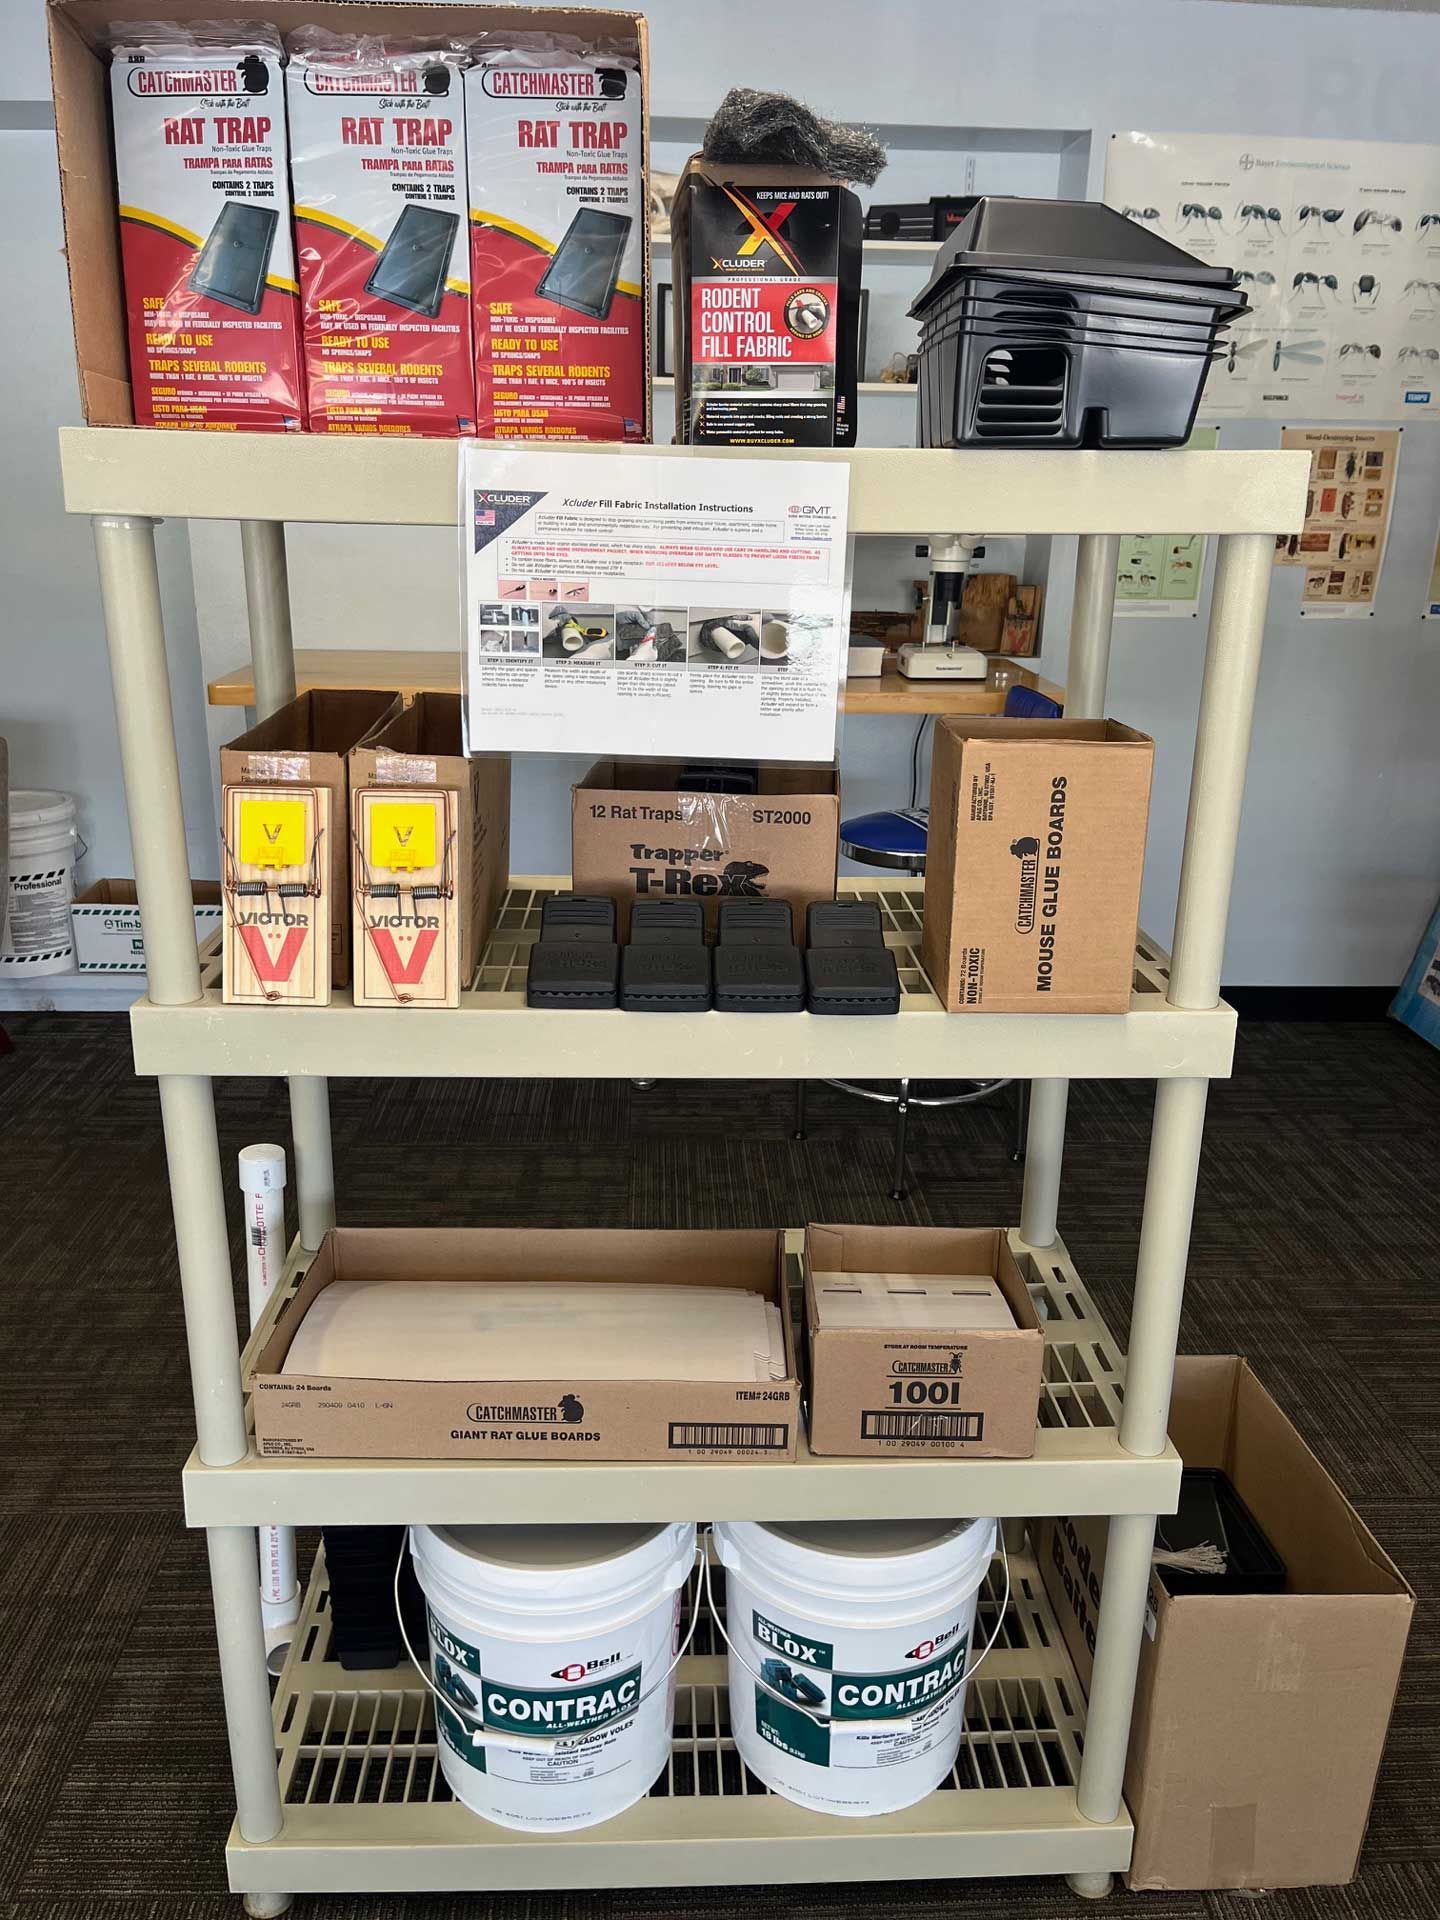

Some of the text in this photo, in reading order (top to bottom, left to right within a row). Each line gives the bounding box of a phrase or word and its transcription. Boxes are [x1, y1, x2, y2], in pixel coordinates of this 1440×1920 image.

[138, 70, 237, 93] CATCHMASTER
[493, 72, 594, 96] CATCHMASTER
[164, 117, 271, 144] RAT TRAP
[342, 117, 452, 146] RAT TRAP
[518, 120, 628, 148] RAT TRAP
[566, 150, 628, 159] Non-Toxic Glue Traps
[184, 157, 273, 168] TRAMPA PARA RATAS
[361, 159, 454, 172] TRAMPA PARA RATAS
[536, 162, 628, 174] TRAMPA PARA RATAS
[212, 181, 274, 190] CONTAINS 2 TRAPS
[566, 187, 628, 196] CONTAINS 2 TRAPS
[756, 192, 829, 200] KEEPS MICE AND RATS OUT!
[711, 256, 765, 271] XCLUDER
[143, 298, 164, 310] SAFE
[702, 288, 761, 308] RODENT
[319, 300, 342, 312] SAFE
[490, 303, 512, 314] SAFE
[702, 312, 774, 334] CONTROL
[145, 333, 214, 346] READY TO USE
[321, 336, 390, 349] READY TO USE
[492, 338, 558, 351] READY TO USE
[702, 336, 792, 358] FILL FABRIC
[149, 360, 267, 374] TRAPS SEVERAL RODENTS
[323, 362, 443, 376] TRAPS SEVERAL RODENTS
[492, 364, 610, 378] TRAPS SEVERAL RODENTS
[478, 492, 530, 504] XCLUDER
[563, 498, 754, 513] Xcluder Fill Fabric Installation Instructions
[802, 506, 831, 514] GMT
[590, 805, 811, 825] 12 Rat Traps ST2000
[630, 844, 724, 866] Trapper
[14, 878, 62, 891] Professional
[630, 868, 751, 897] T-Rex
[1036, 776, 1068, 992] MOUSE GLUE BOARDS
[1017, 859, 1036, 928] CATCHMASTER
[240, 912, 308, 926] VICTOR
[370, 915, 440, 928] VICTOR
[960, 970, 966, 978] 72
[966, 947, 980, 1005] NON-TOXIC
[958, 978, 966, 1005] CONTAINS:
[898, 1362, 949, 1373] CATCHMASTER
[306, 1384, 332, 1392] Boards
[476, 1406, 556, 1420] CATCHMASTER
[450, 1430, 600, 1441] GIANT RAT GLUE BOARDS
[901, 1440, 925, 1448] 29049
[935, 1624, 959, 1644] Bell
[758, 1623, 816, 1663] BLOX
[586, 1652, 620, 1670] Bell
[838, 1649, 964, 1706] CONTRAC
[488, 1680, 636, 1721] CONTRAC
[546, 1712, 608, 1729] ALL-WEATHER
[610, 1720, 633, 1735] VOLES
[761, 1728, 788, 1752] 18 lbs
[894, 1735, 920, 1746] CAUTION
